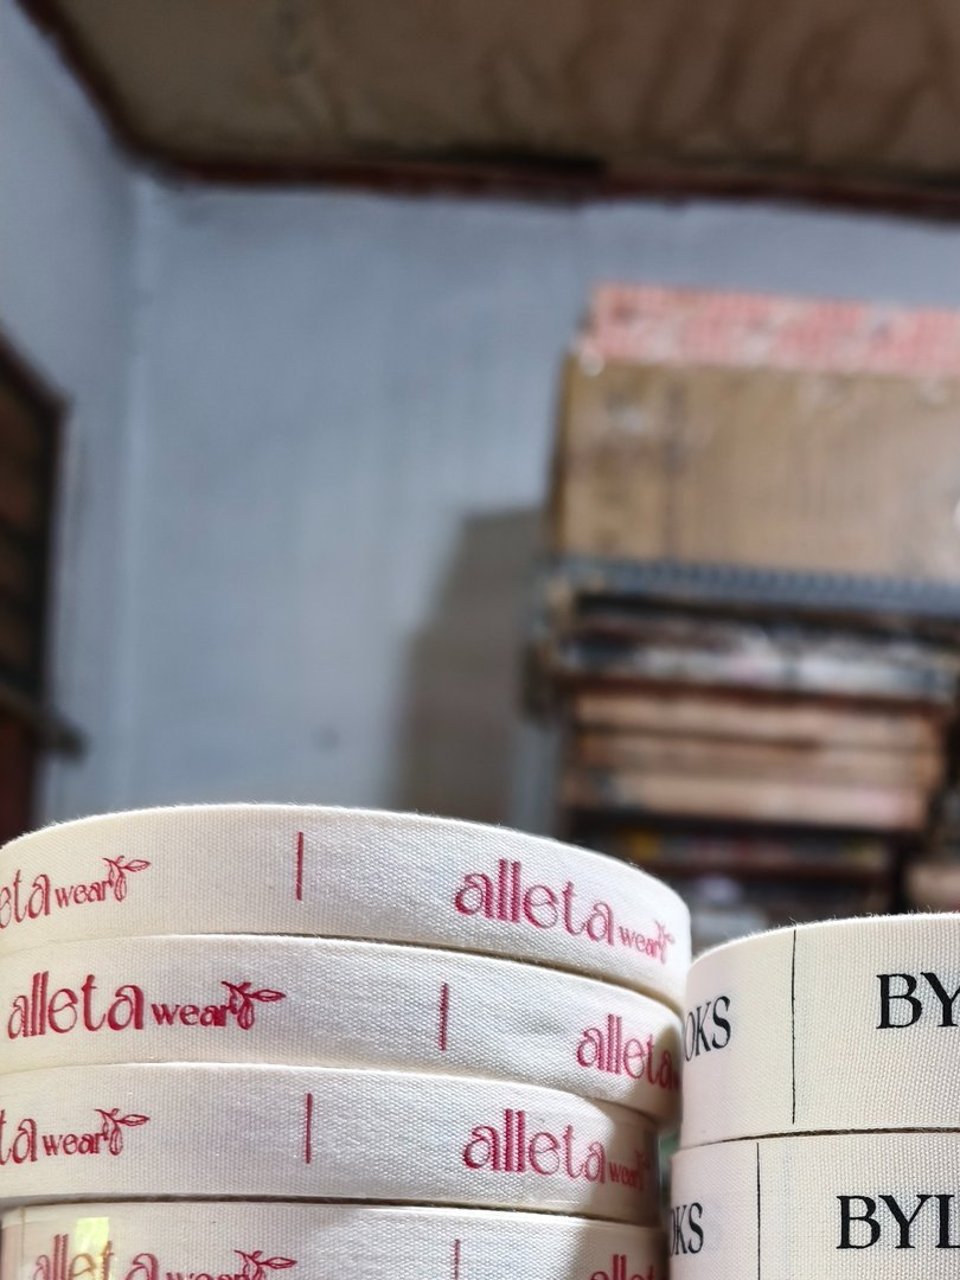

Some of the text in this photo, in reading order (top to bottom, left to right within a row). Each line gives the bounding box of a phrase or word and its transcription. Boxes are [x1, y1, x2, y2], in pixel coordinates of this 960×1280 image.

[55, 880, 113, 909] wear
[455, 860, 615, 945] alleta
[7, 971, 234, 1039] alleta wear
[576, 1014, 672, 1089] alleta
[42, 1132, 106, 1156] wear
[463, 1109, 606, 1184] alleta
